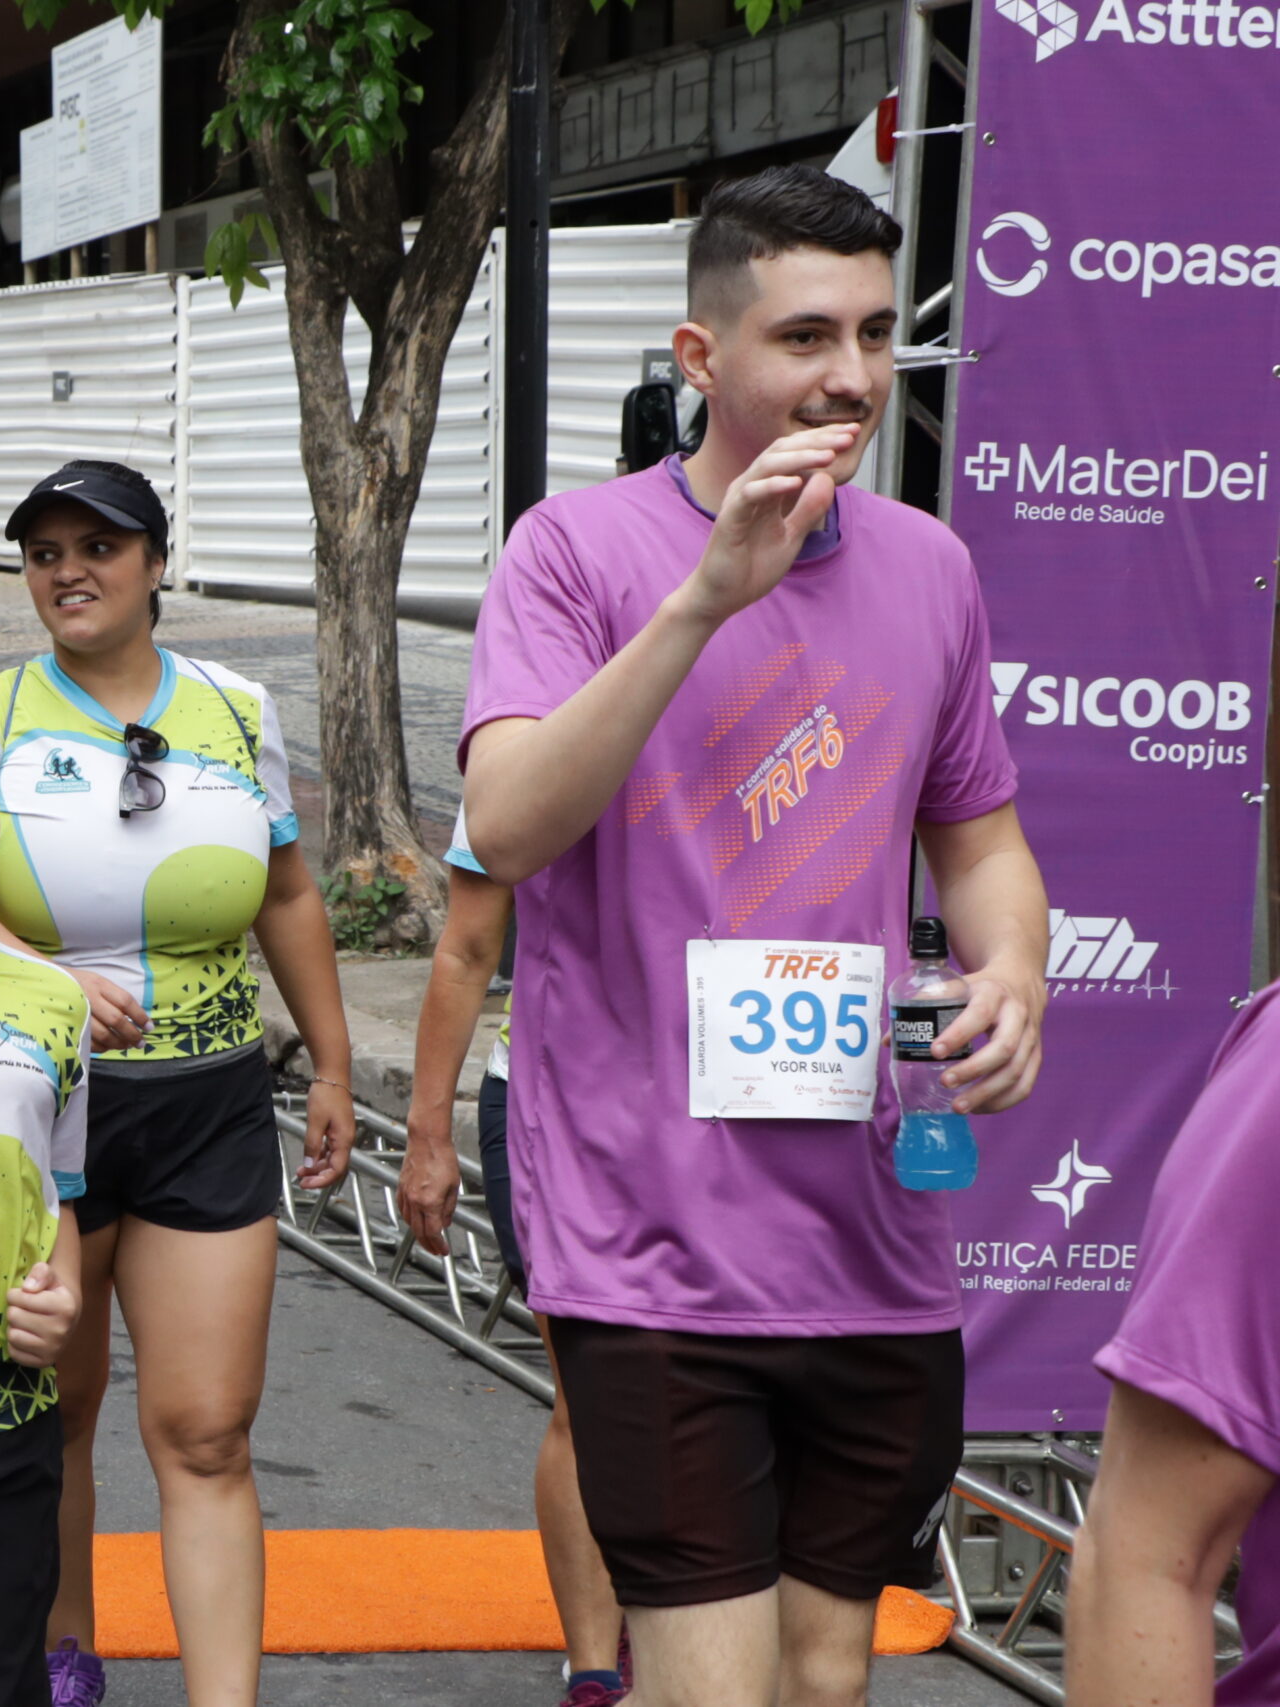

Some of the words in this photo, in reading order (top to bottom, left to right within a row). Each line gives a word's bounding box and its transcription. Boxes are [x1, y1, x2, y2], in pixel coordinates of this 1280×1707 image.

[1084, 0, 1280, 49] Asttte
[60, 93, 82, 123] PGC
[1070, 239, 1280, 298] copasa
[1015, 501, 1066, 521] Rede
[1070, 504, 1095, 522] de
[1098, 504, 1165, 525] Saúde
[1025, 675, 1251, 731] SICOOB
[746, 755, 775, 789] corrida
[813, 704, 827, 719] do
[1130, 736, 1248, 770] Coopjus
[742, 714, 844, 843] TRF6
[764, 954, 840, 981] TRF6
[697, 997, 706, 1038] VOLUMES
[729, 989, 869, 1058] 395
[895, 1021, 934, 1032] POWER
[697, 1040, 706, 1077] GUARDA
[771, 1060, 808, 1073] YGOR
[811, 1061, 843, 1074] SILVA
[956, 1242, 1058, 1274] USTIÇA
[1067, 1244, 1137, 1269] FEDE
[983, 1275, 1050, 1294] Regional
[1054, 1276, 1111, 1292] Federal
